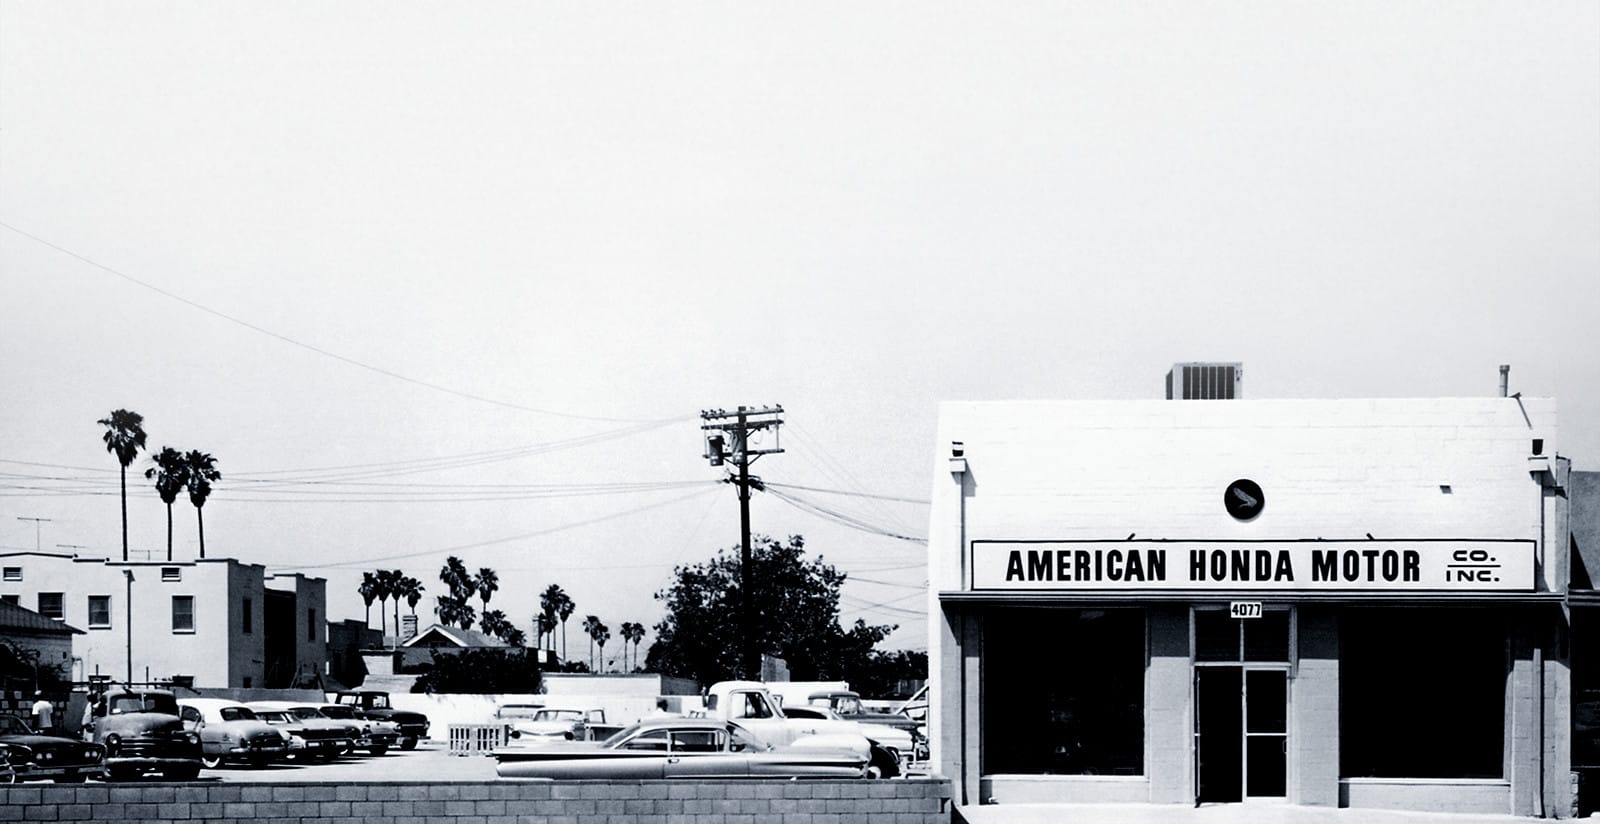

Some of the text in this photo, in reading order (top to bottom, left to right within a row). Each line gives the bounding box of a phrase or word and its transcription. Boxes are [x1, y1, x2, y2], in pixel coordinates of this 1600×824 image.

[1453, 550, 1497, 562] CO.
[1006, 549, 1420, 582] AMERICAN HONDA MOTOR
[1446, 570, 1500, 582] INC.
[1231, 603, 1261, 617] 4077
